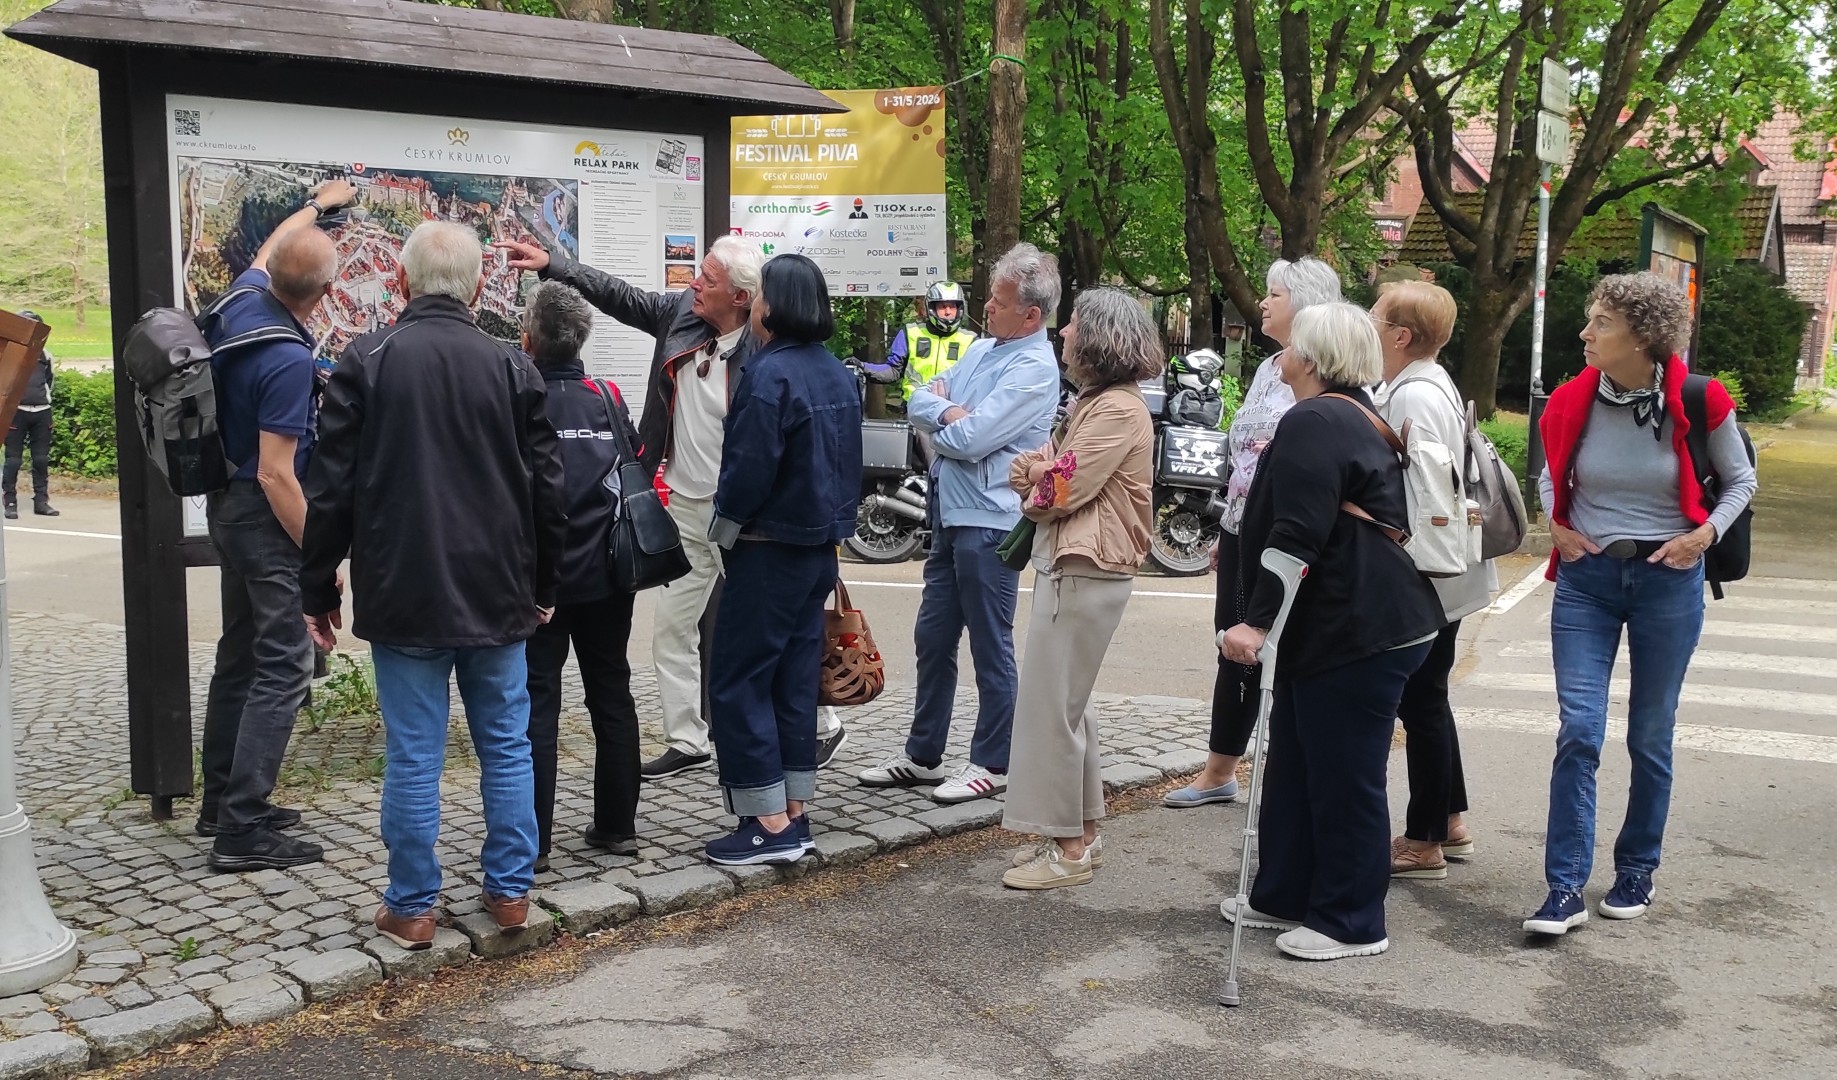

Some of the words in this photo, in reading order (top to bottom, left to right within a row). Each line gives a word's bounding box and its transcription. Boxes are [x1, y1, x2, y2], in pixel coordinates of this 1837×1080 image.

[883, 94, 940, 107] 1-31/5/2026
[175, 140, 257, 152] www.ckrumlov.info
[404, 147, 443, 160] ČESKÝ
[448, 151, 511, 165] KRUMLOV
[735, 144, 812, 162] FESTIVAL
[818, 143, 858, 162] PIVA
[574, 158, 609, 168] RELAX
[612, 160, 640, 170] PARK
[763, 172, 787, 181] ČESKÝ
[790, 172, 828, 181] KRUMLOV
[748, 202, 811, 214] carthamus
[874, 204, 906, 212] TISOX
[829, 228, 868, 238] Kostečka
[866, 249, 903, 257] PODLAHY
[556, 429, 614, 440] RSCHE
